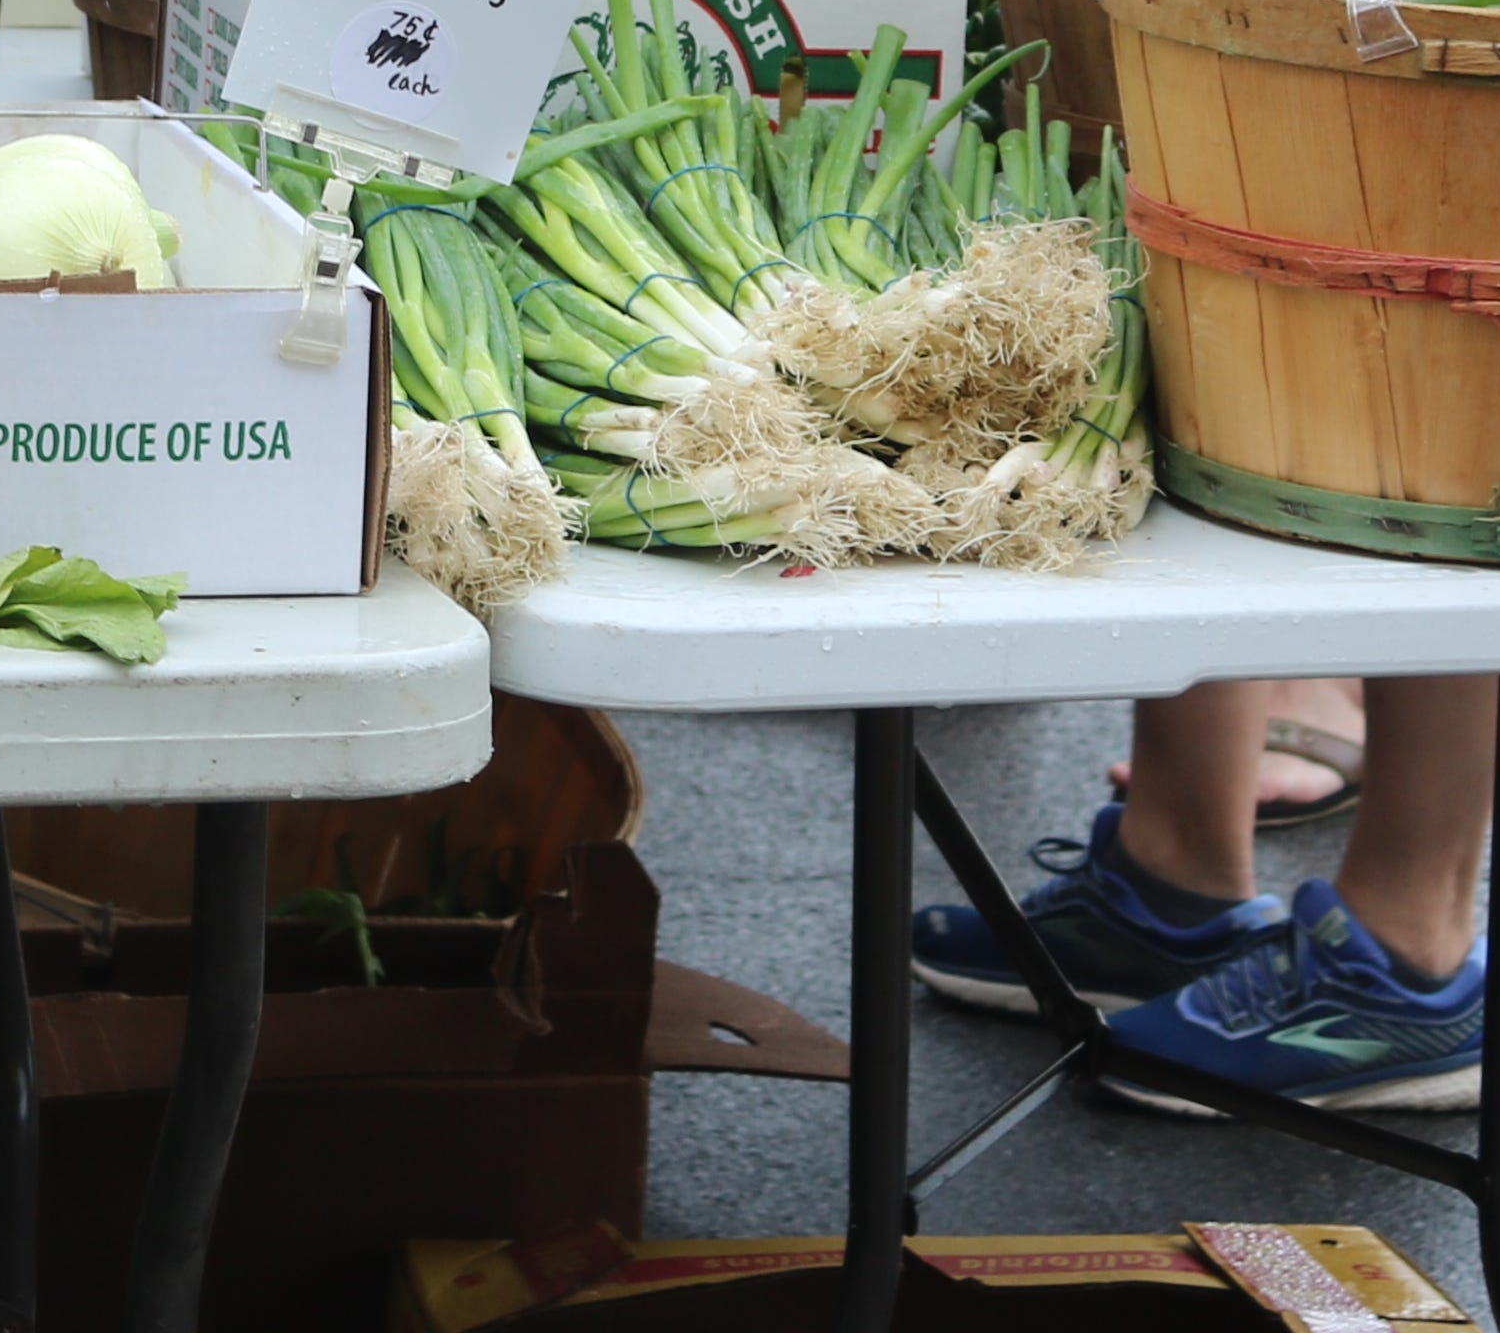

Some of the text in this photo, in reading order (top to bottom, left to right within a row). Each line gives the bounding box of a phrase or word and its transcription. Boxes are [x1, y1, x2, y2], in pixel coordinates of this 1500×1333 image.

[388, 72, 441, 97] each
[165, 421, 212, 463] OF
[222, 420, 292, 462] USA
[959, 1250, 1174, 1273] California
